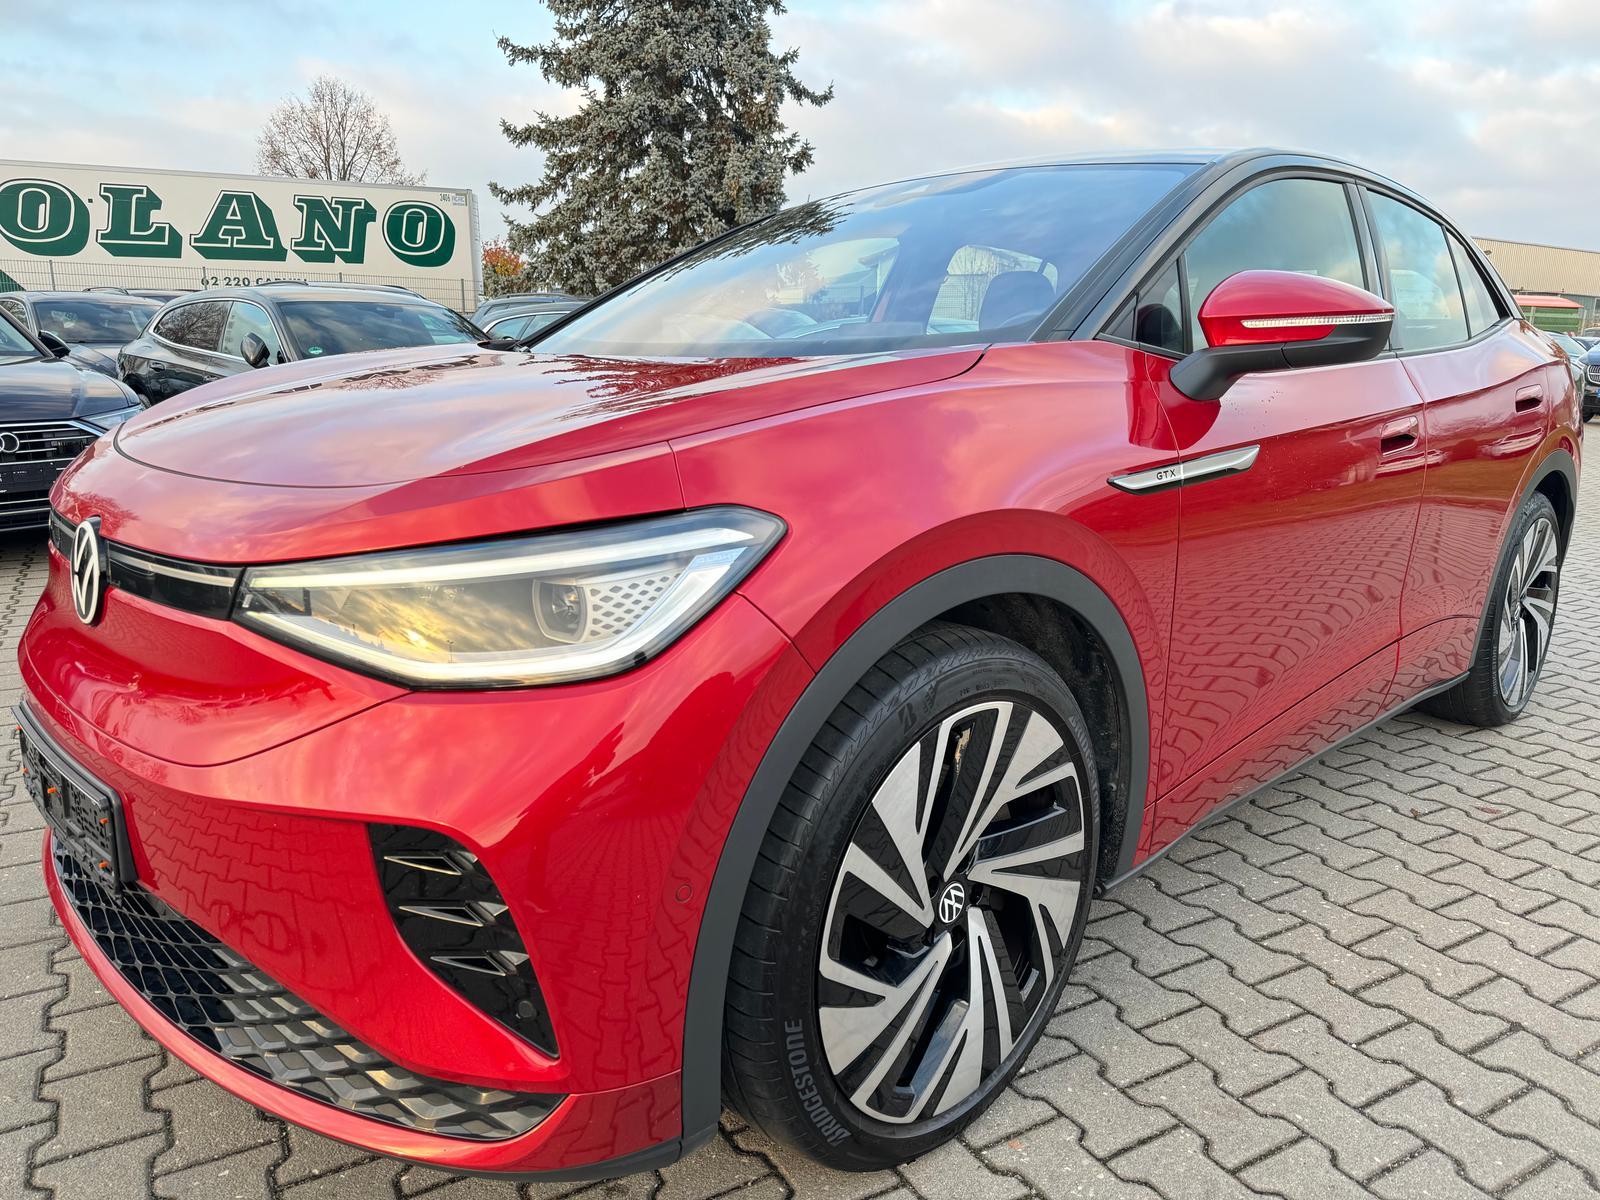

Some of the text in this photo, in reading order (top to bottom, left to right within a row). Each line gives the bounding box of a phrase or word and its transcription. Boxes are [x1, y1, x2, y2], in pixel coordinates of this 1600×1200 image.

[0, 178, 456, 267] OLANO
[224, 276, 250, 287] 220
[1156, 468, 1176, 481] GTX
[784, 1016, 852, 1148] BRIDGESTONE
